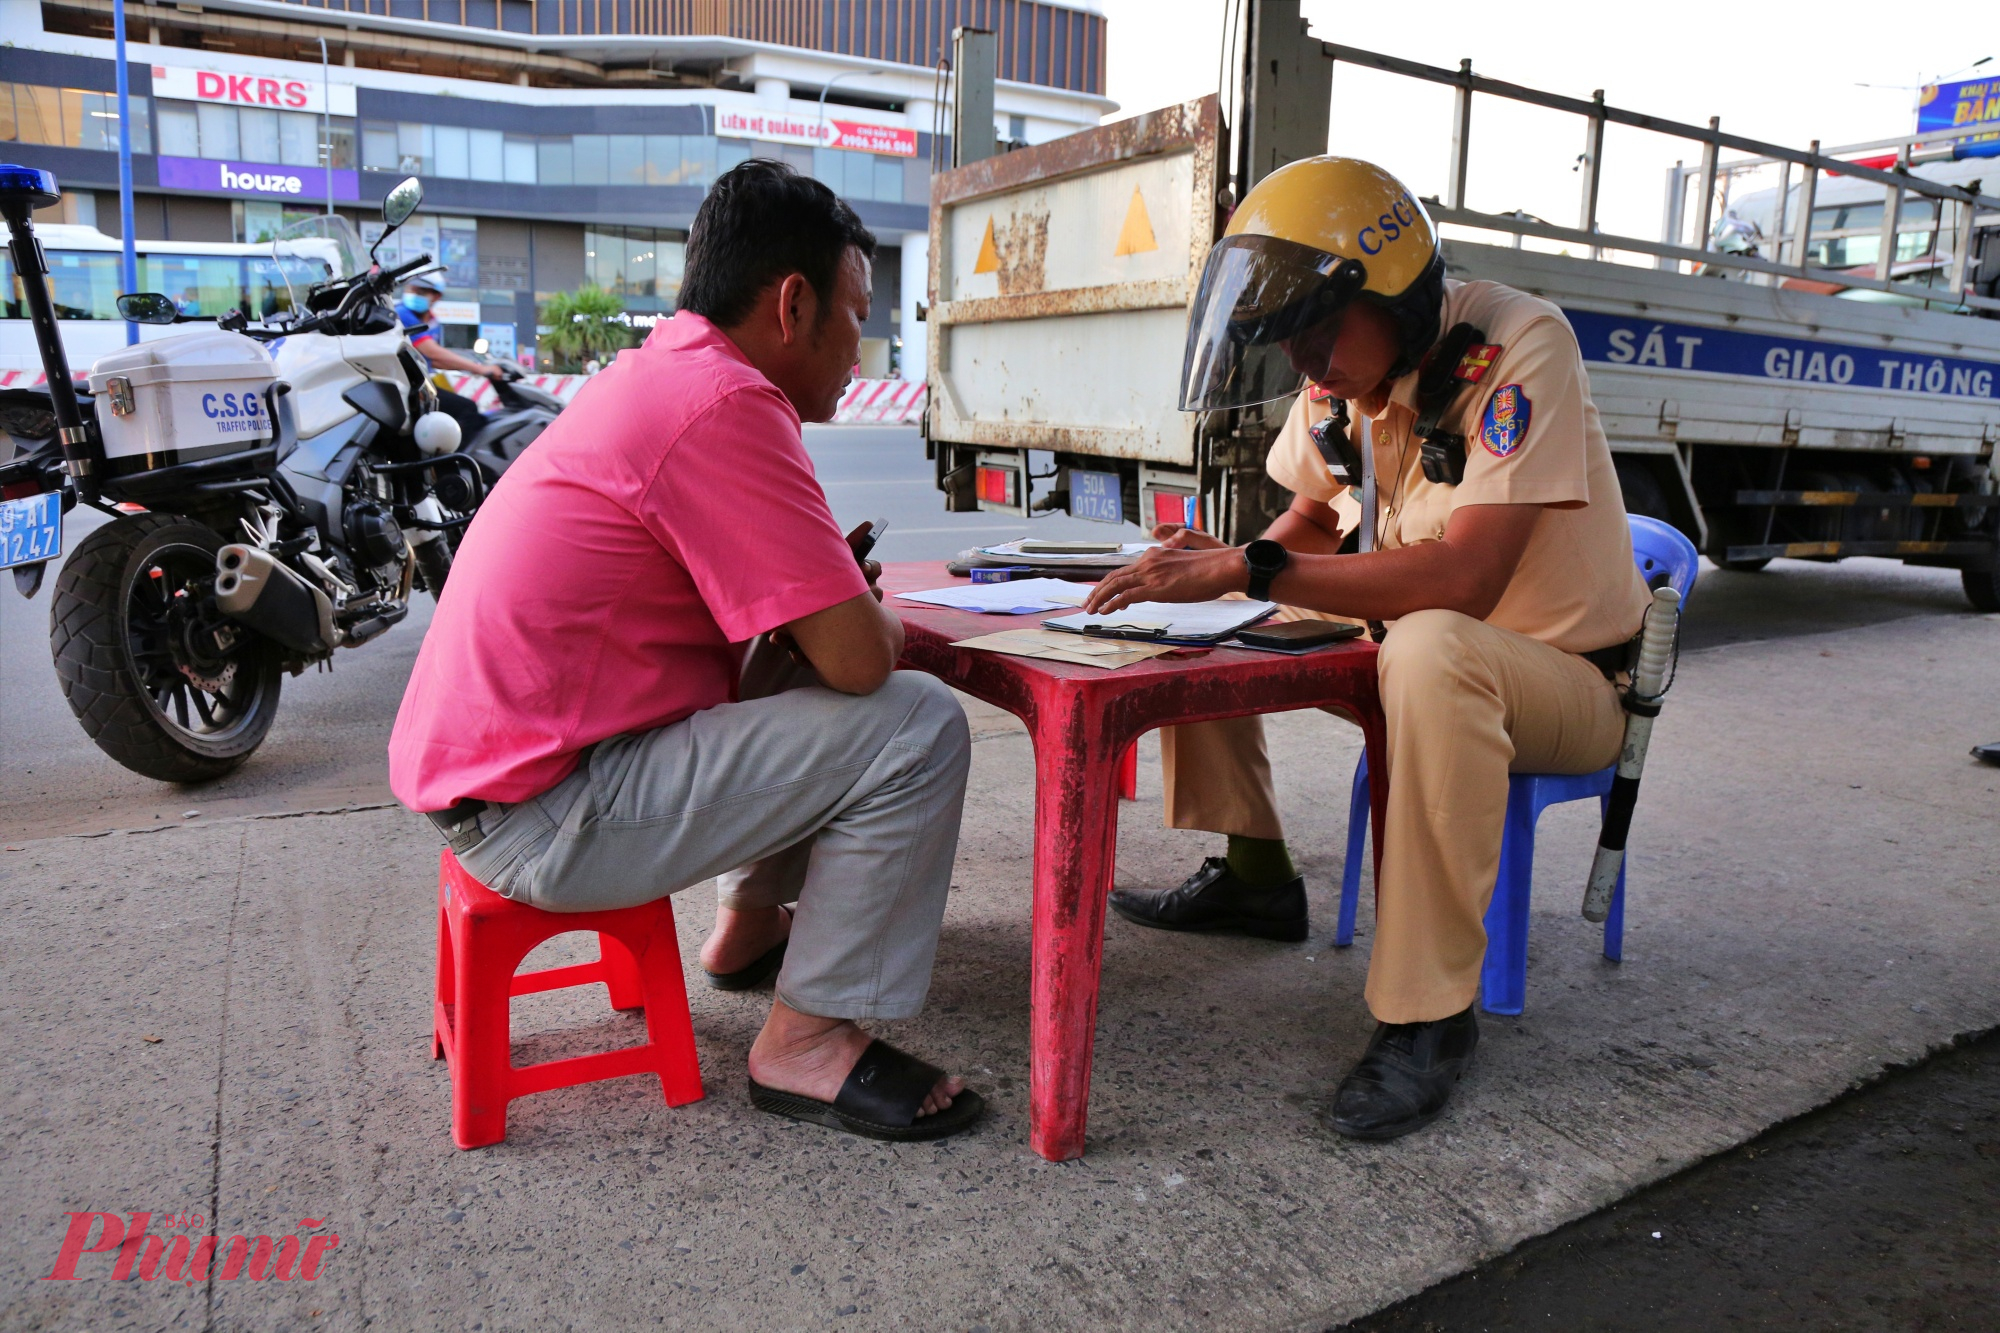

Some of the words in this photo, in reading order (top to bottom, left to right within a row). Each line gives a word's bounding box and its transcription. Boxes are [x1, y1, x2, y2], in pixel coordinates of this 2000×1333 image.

[197, 71, 307, 108] DKRS
[721, 113, 747, 130] LIÊN
[750, 116, 764, 134] HỆ
[1606, 325, 1703, 369] SÁT
[1763, 346, 1855, 384] GIAO
[1878, 360, 1993, 398] THÔNG
[216, 421, 247, 433] TRAFFIC
[1485, 419, 1524, 438] CSGT
[1083, 474, 1106, 496] 50A
[0, 497, 48, 533] 9-A1
[1075, 495, 1117, 519] 017.45
